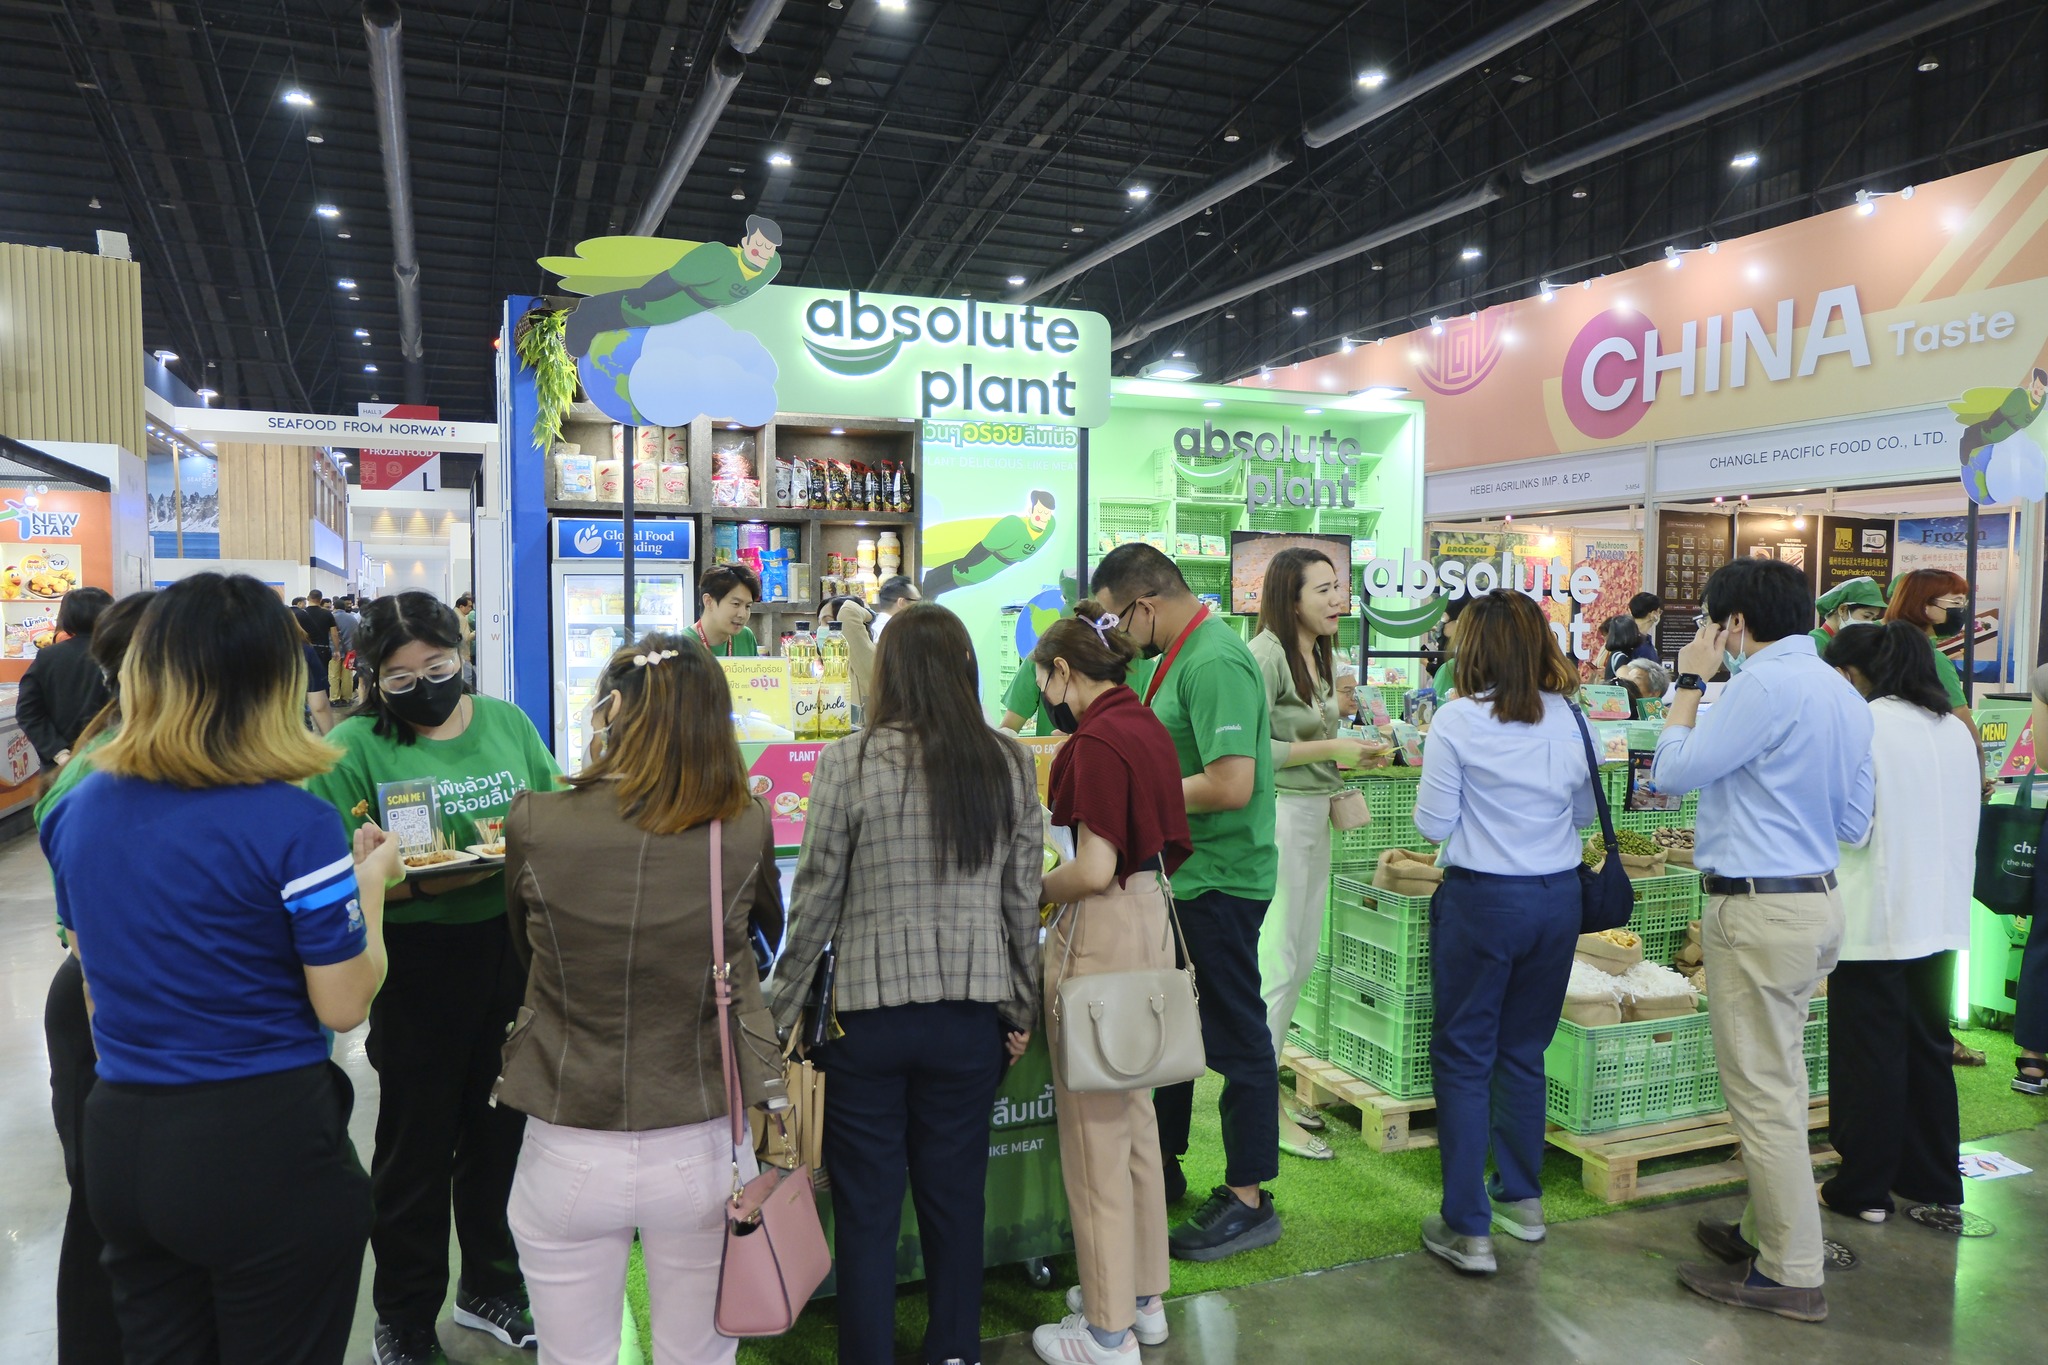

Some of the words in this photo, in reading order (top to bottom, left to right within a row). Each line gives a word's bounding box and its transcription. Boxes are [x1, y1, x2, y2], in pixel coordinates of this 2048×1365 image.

[806, 289, 1079, 353] absolute
[1581, 284, 1871, 412] CHINA
[1888, 309, 2016, 356] Taste
[921, 363, 1077, 418] plant
[268, 417, 337, 431] SEAFOOD
[343, 421, 383, 434] FROM
[390, 424, 447, 437] NORWAY
[1174, 419, 1361, 466] absolute
[1709, 451, 1768, 469] CHANGLE
[1772, 444, 1825, 462] PACIFIC
[1830, 439, 1871, 455] FOOD
[1876, 435, 1908, 450] CO.,
[1913, 431, 1948, 446] LTD.
[369, 448, 406, 457] FROZEN
[407, 449, 433, 458] FOOD
[959, 457, 1023, 469] DELICIOUS
[422, 472, 435, 491] L
[1470, 485, 1494, 495] HEBEI
[1495, 477, 1539, 492] AGRILINKS
[1542, 475, 1560, 487] IMP.
[1562, 474, 1569, 484] &
[1572, 472, 1593, 484] EXP.
[1247, 467, 1356, 513] plant
[32, 513, 79, 526] NEW
[32, 525, 71, 536] STAR
[603, 530, 643, 542] Gloal
[645, 530, 675, 542] Food
[1922, 529, 1987, 543] Frozn
[615, 541, 663, 555] Tding
[1446, 546, 1487, 554] BROCCOLI
[1585, 545, 1625, 560] Frozen
[1596, 541, 1628, 550] Mushrooms
[1363, 547, 1601, 604] absolute
[750, 675, 779, 690] องุ่น
[1981, 722, 2007, 741] MENU
[789, 750, 816, 762] PLANT
[387, 794, 409, 806] SCAN
[410, 792, 421, 803] ME
[2007, 859, 2020, 867] the
[988, 1144, 1008, 1157] IKE
[1011, 1138, 1045, 1154] MEAT
